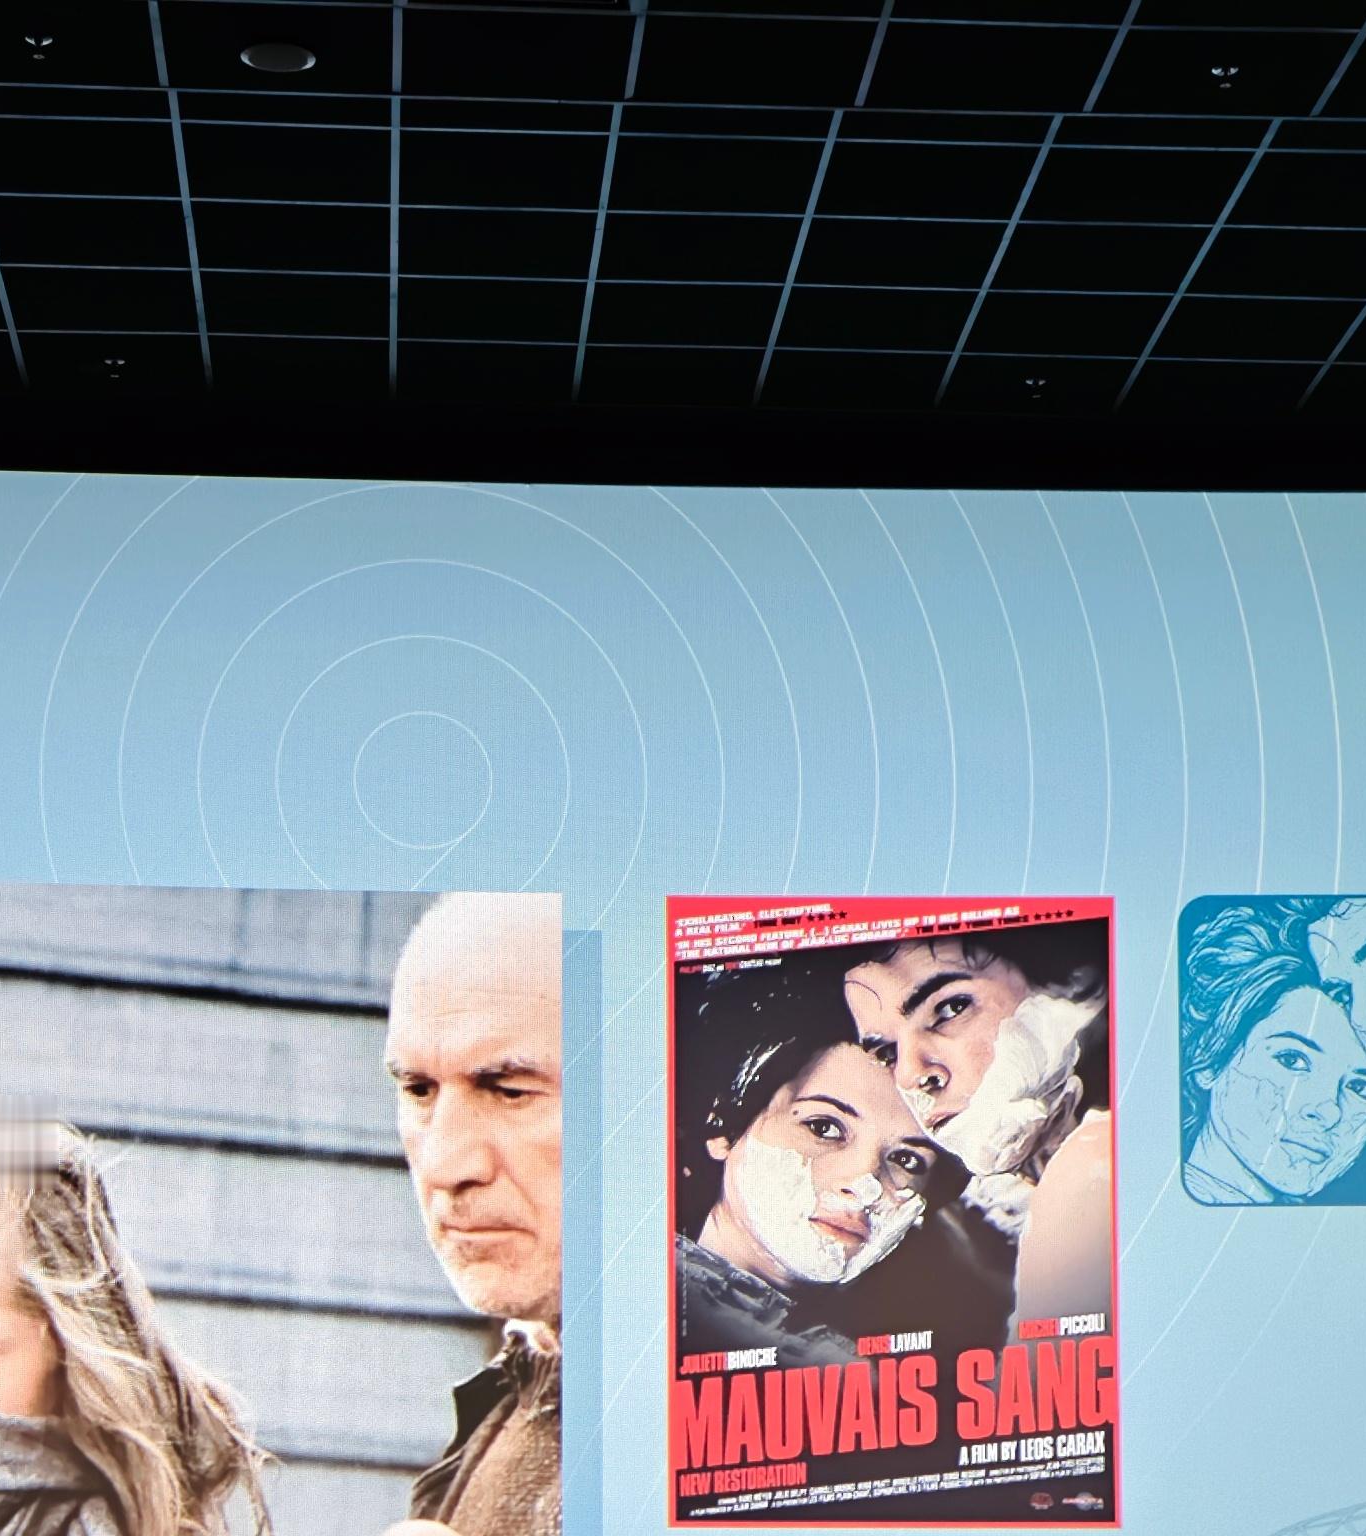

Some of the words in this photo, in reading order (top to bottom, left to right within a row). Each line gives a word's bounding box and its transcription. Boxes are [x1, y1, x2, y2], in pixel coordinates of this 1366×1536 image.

[674, 1354, 937, 1469] MAUVAIS
[956, 1336, 1116, 1440] SANG
[959, 1446, 969, 1466] A
[971, 1442, 998, 1464] FILM
[1000, 1440, 1018, 1462] BY
[1020, 1436, 1053, 1462] LEOS
[1056, 1431, 1105, 1458] CARAX
[679, 1472, 711, 1497] NEW
[714, 1462, 806, 1494] RESTORATION
